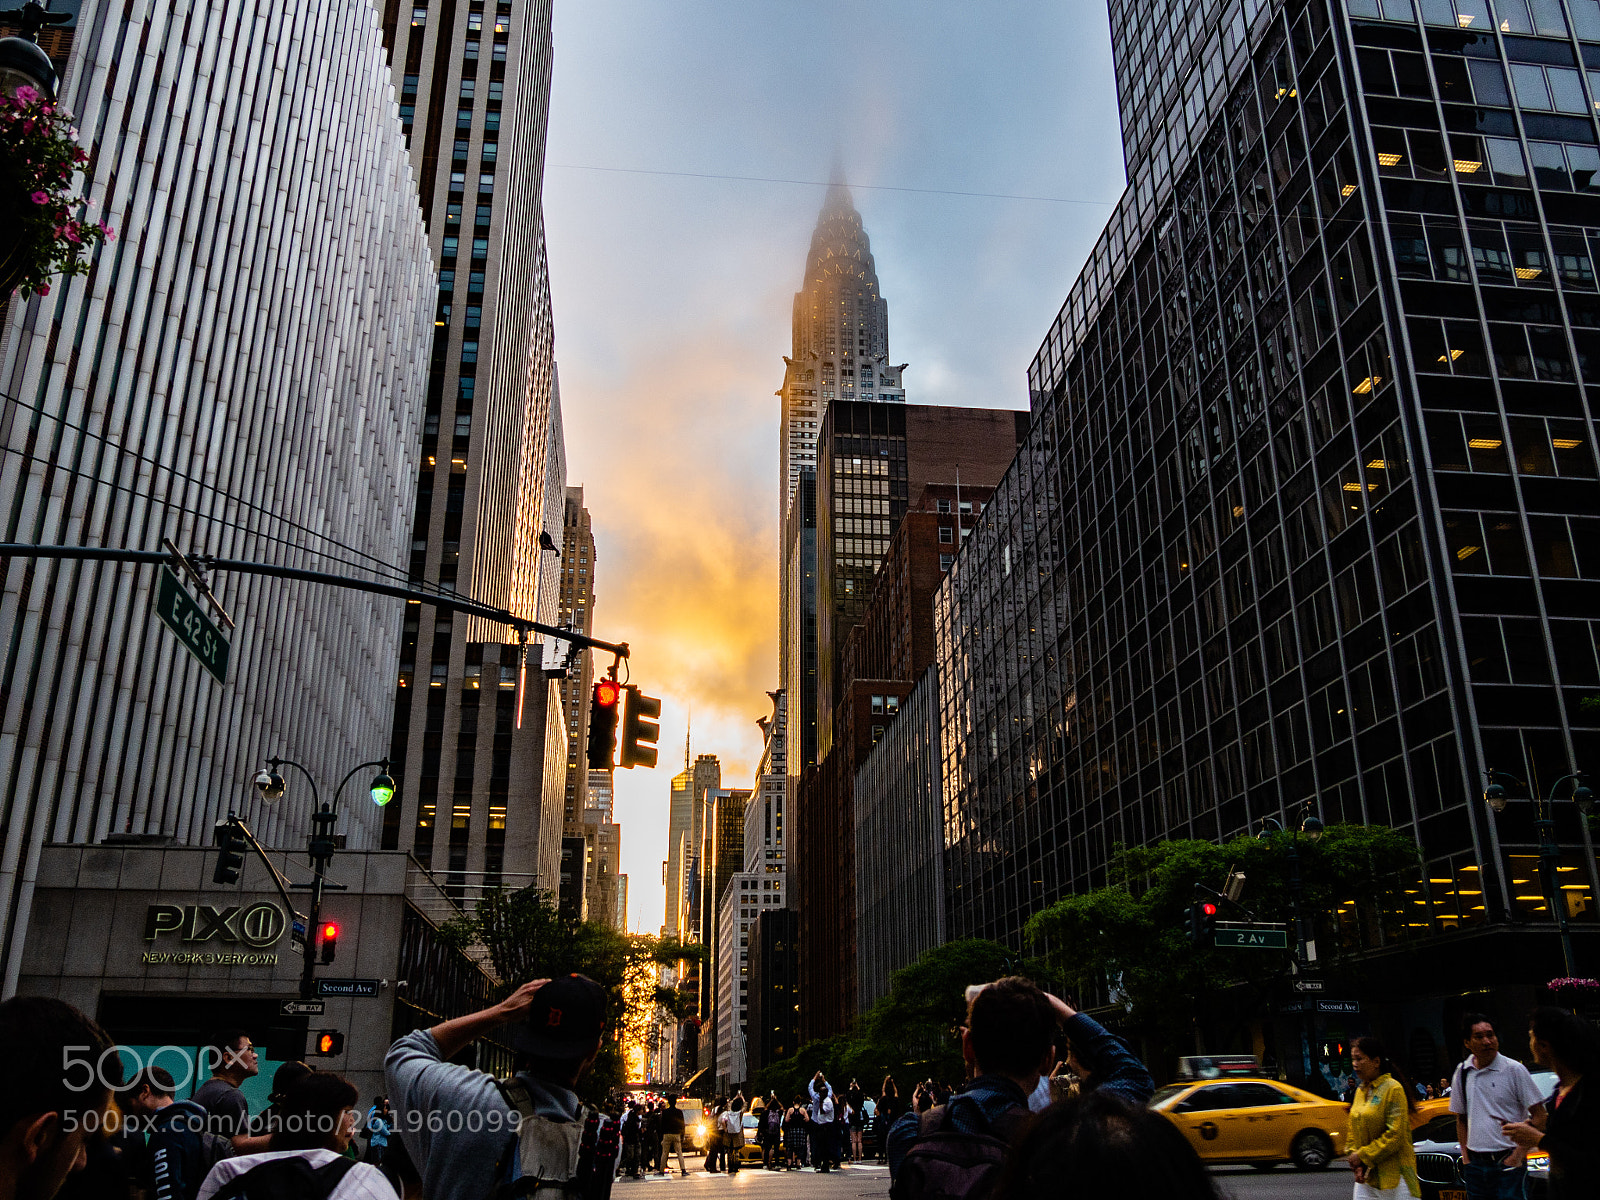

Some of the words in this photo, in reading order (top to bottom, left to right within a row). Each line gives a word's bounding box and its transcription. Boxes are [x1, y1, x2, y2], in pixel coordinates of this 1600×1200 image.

[172, 592, 183, 624] E
[183, 610, 202, 646] 42
[203, 630, 218, 665] St
[1237, 933, 1245, 943] 2
[1249, 933, 1265, 944] Av
[142, 952, 170, 963] NEW
[171, 952, 215, 965] YORK'S
[215, 953, 247, 965] VERY
[248, 953, 278, 965] OWN
[322, 983, 354, 992] Second
[355, 984, 373, 993] Ave
[1320, 1002, 1343, 1010] Second
[1344, 1003, 1356, 1011] Ave
